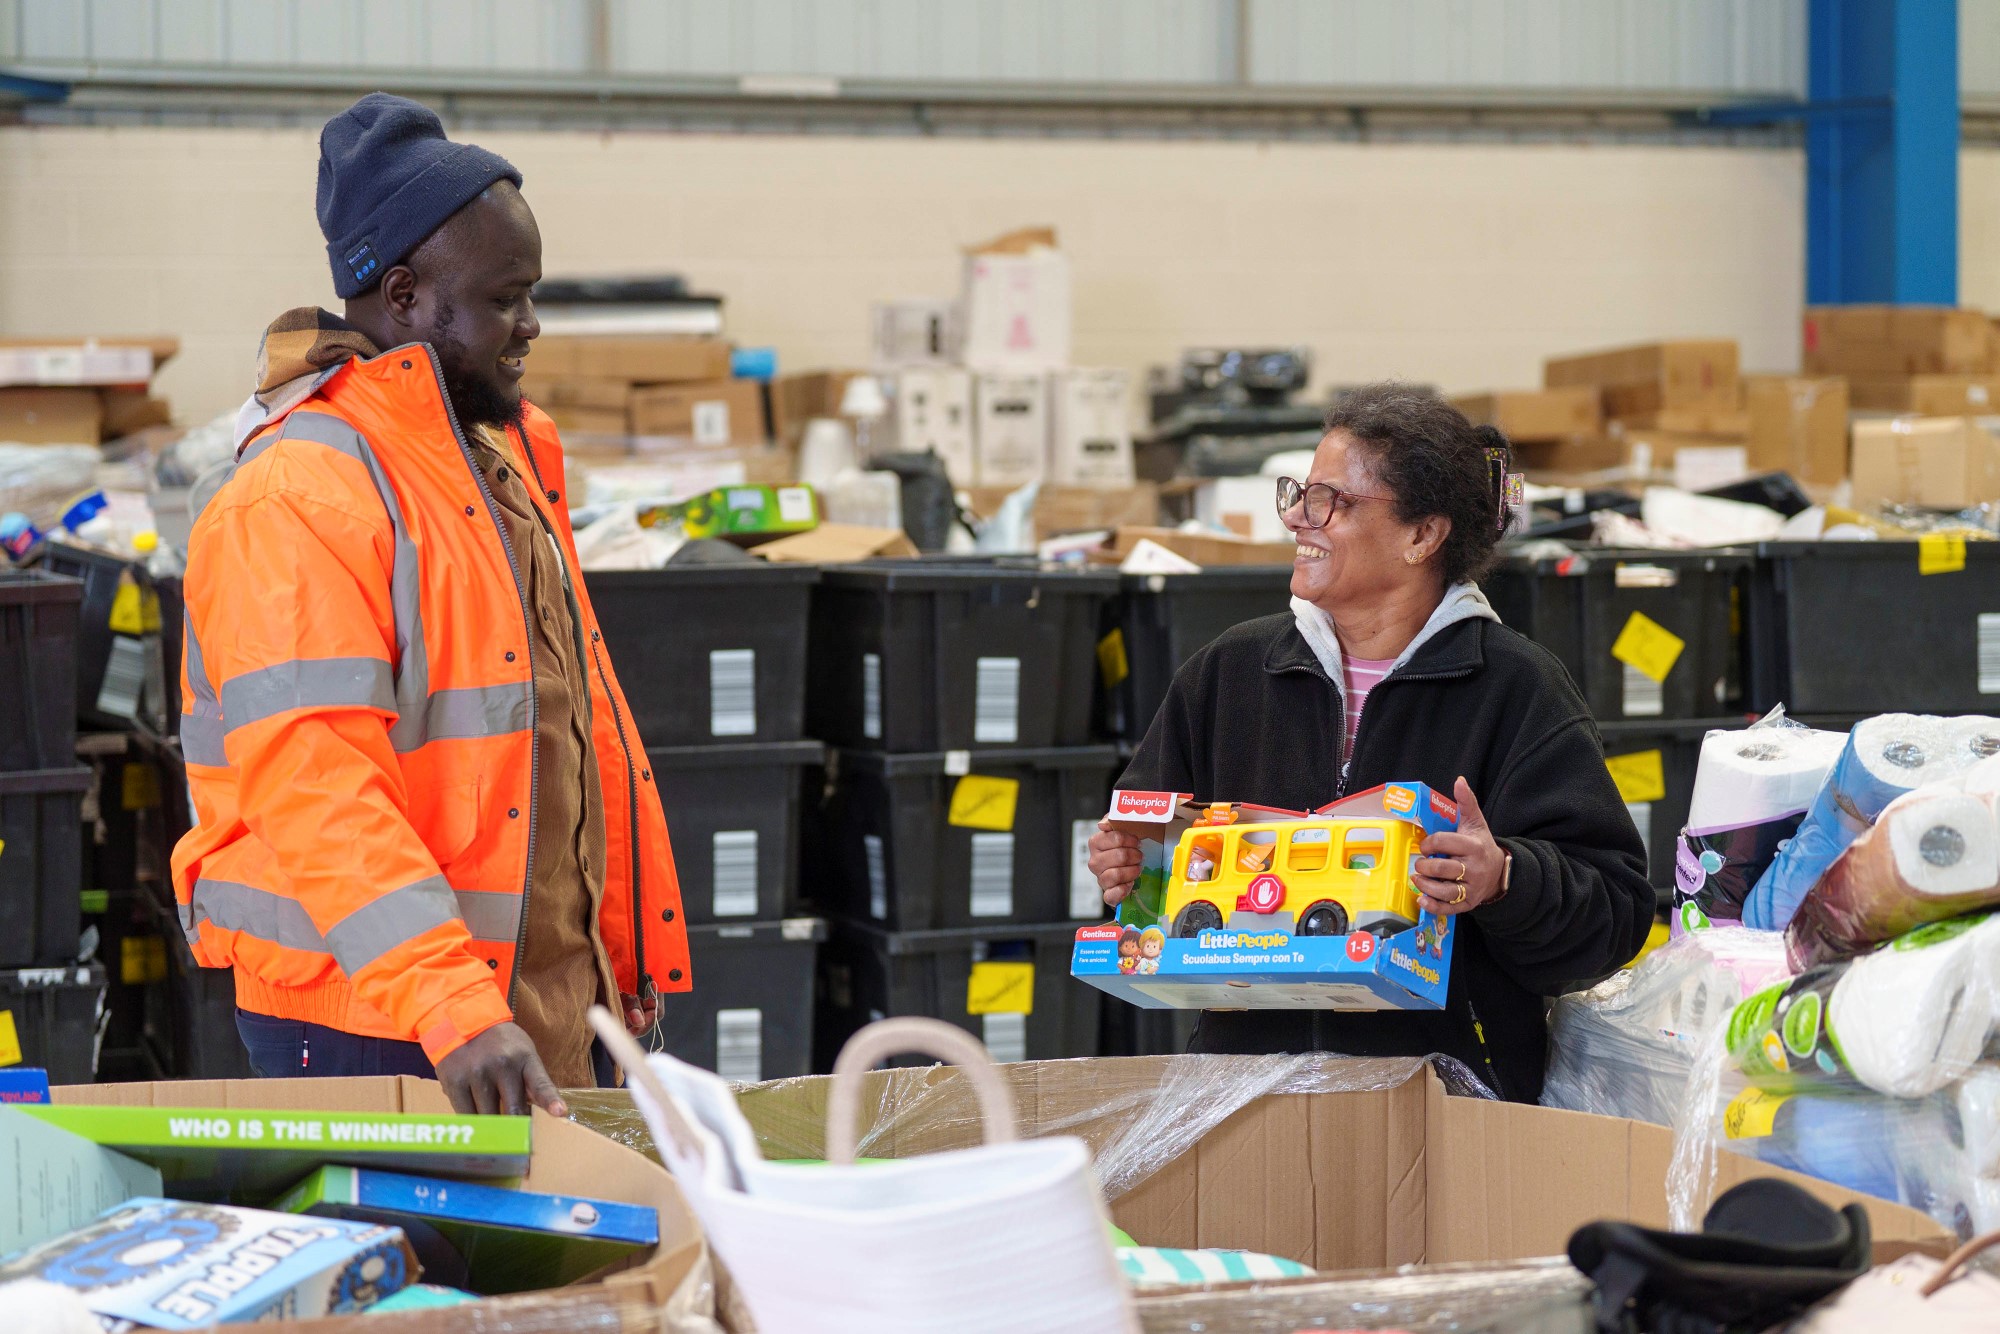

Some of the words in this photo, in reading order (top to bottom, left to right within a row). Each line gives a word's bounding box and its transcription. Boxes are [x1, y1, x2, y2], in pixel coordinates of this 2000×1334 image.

[1121, 795, 1167, 809] fisher-price
[1431, 794, 1457, 816] fisher-price
[1082, 929, 1117, 939] Gentilezza
[1350, 940, 1371, 953] 1-5
[1182, 953, 1232, 965] Scuolabus
[1232, 952, 1271, 966] Sempre
[1272, 954, 1291, 963] con
[1292, 951, 1305, 963] Te
[169, 1117, 231, 1139] WHO
[237, 1119, 264, 1140] IS
[270, 1120, 323, 1141] THE
[329, 1121, 475, 1144] WINNER???
